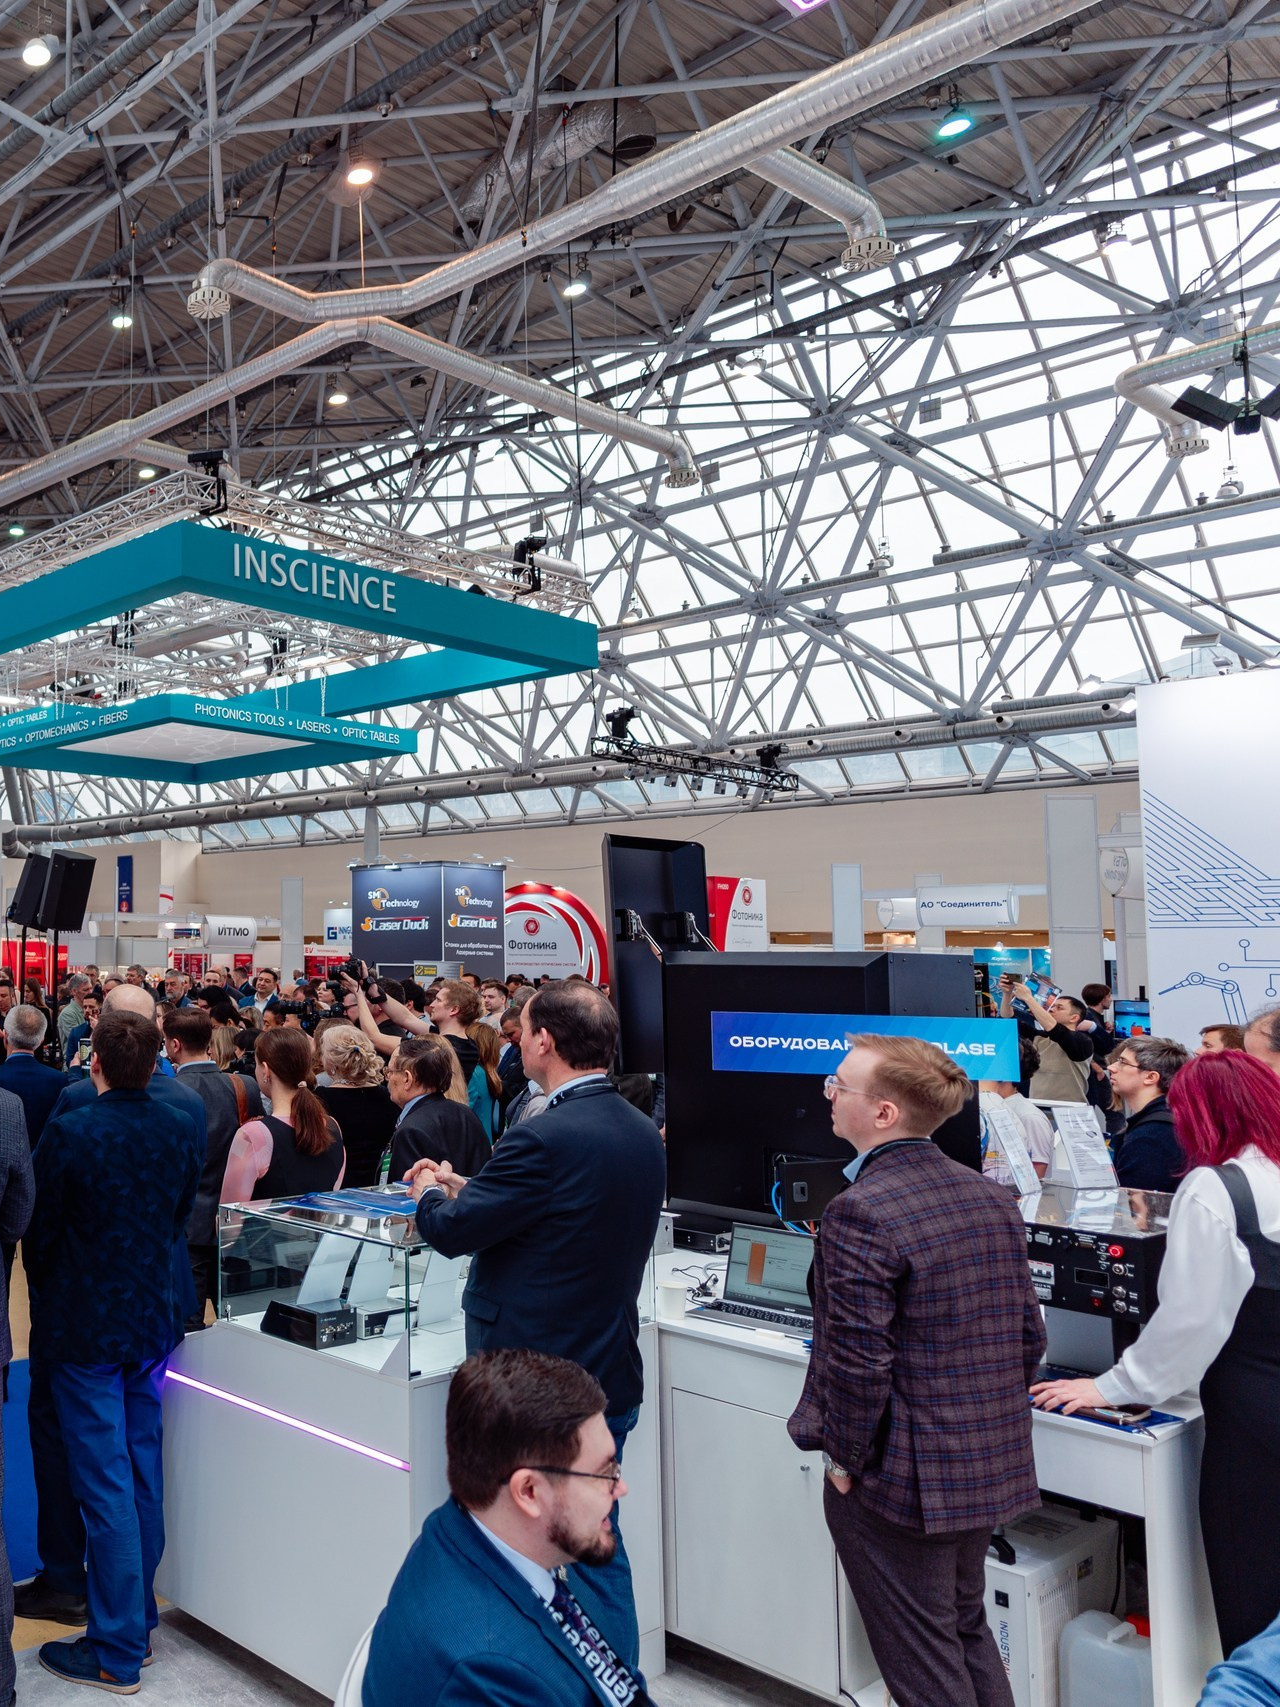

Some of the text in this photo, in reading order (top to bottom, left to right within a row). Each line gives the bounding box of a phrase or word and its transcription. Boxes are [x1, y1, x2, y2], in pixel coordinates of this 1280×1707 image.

[234, 543, 396, 613] INSCIENCE
[7, 716, 25, 727] OPTIC
[26, 710, 48, 723] TABLES
[195, 703, 400, 744] PHOTONICS TOOLS LASERS OPTIC TABLES
[25, 720, 89, 743] OPTOMECHANICS
[98, 709, 129, 727] FIBERS
[368, 891, 380, 899] SM
[455, 887, 465, 896] SM
[380, 899, 420, 909] Technology
[464, 897, 493, 908] Technology
[936, 900, 1007, 909] "Соединитель"
[731, 909, 763, 921] Фотоника
[373, 919, 429, 931] Laser Duck
[457, 917, 497, 929] Laser Duck
[508, 939, 557, 950] Фотоника
[729, 1036, 854, 1051] ОБОРУДОВАН
